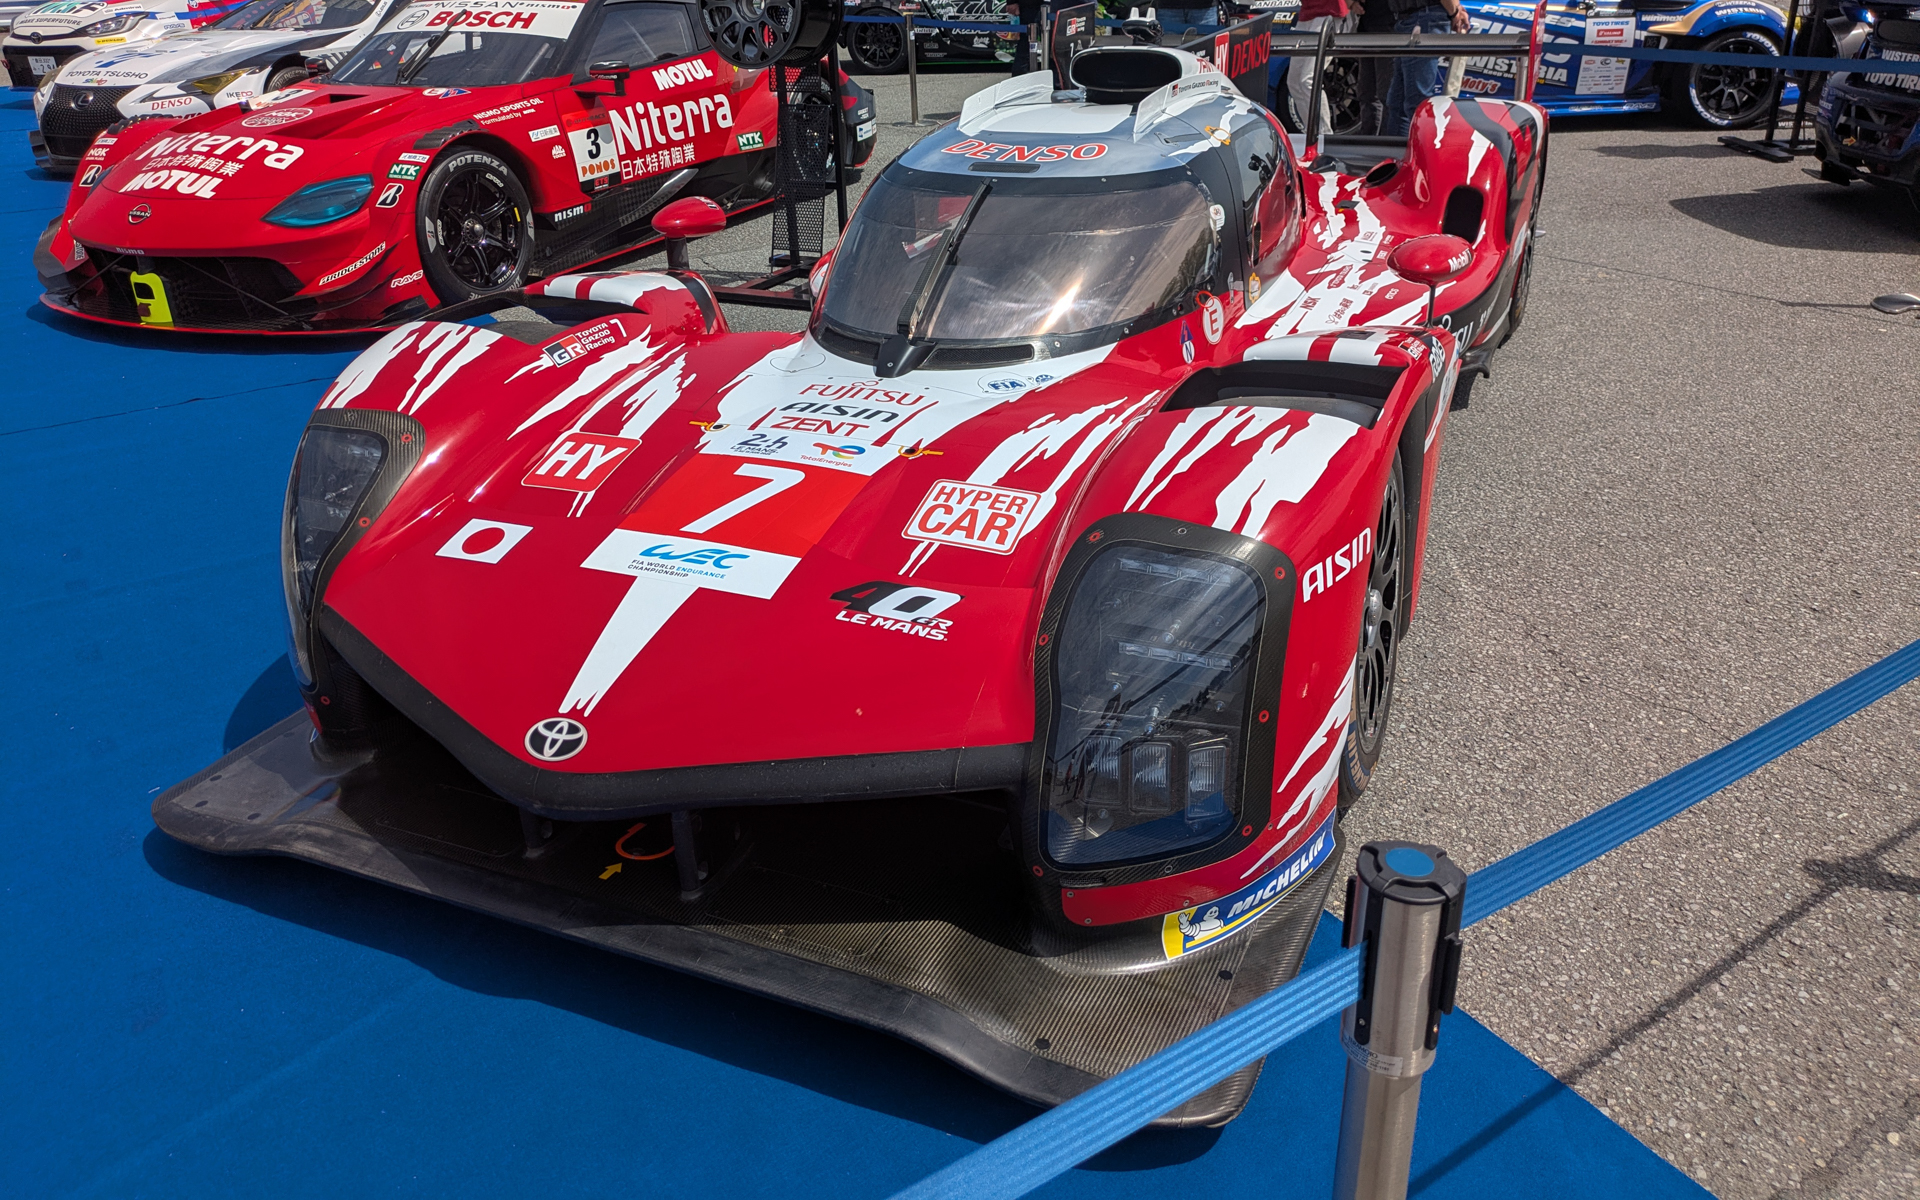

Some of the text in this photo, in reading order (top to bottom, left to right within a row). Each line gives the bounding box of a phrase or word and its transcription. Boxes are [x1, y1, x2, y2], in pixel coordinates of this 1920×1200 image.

[439, 1, 519, 9] NISSAN
[35, 17, 83, 26] SUPERFUTURE
[425, 11, 538, 30] BOSCH
[1274, 12, 1296, 20] ECU
[1231, 31, 1271, 79] DENSO
[103, 71, 149, 79] TSUSHO
[651, 58, 714, 91] MOTUL
[1461, 76, 1499, 93] Moty's
[152, 97, 193, 111] DENSO
[226, 91, 253, 99] IKEDO
[473, 98, 544, 120] NISMO SPORTS OIL
[481, 113, 514, 125] Formulated
[609, 93, 735, 156] Niterra
[586, 127, 602, 160] 3
[738, 131, 763, 146] NTK
[88, 148, 110, 157] NGK
[136, 131, 305, 170] Niterra
[621, 142, 696, 180] 日本特殊陶業
[941, 138, 1109, 163] DENSO
[142, 153, 245, 178] 日本特殊陶業
[390, 163, 421, 176] NTK
[448, 154, 508, 177] POTENZA
[580, 158, 616, 178] PONOS
[118, 169, 225, 199] MOTUL
[594, 176, 609, 187] ETS
[554, 203, 592, 222] nismo
[116, 247, 145, 255] nismo
[319, 241, 386, 287] BRIDGESTONE
[391, 269, 423, 288] RAYS
[1300, 296, 1321, 310] NSK
[575, 322, 608, 339] TOYOTA
[609, 318, 627, 338] 7
[1208, 308, 1219, 335] E
[580, 329, 611, 344] GAZOO
[585, 335, 615, 351] Racing
[552, 343, 585, 364] GR
[1184, 341, 1194, 363] N
[798, 382, 927, 407] FUJITSU
[989, 380, 1023, 391] FIA
[779, 402, 900, 423] AISIN
[769, 416, 870, 437] ZENT
[535, 440, 628, 481] HY
[800, 454, 853, 468] TotalEnergies
[679, 462, 806, 535] 7
[932, 485, 1029, 515] HYPER
[918, 503, 1016, 546] CAR
[639, 544, 751, 570] WEC
[1302, 527, 1371, 604] AISIN
[627, 564, 689, 578] CHAMPIONSHIP
[646, 560, 676, 571] WORLD
[675, 566, 727, 579] ENDURANCE
[829, 580, 967, 622] 40
[835, 610, 949, 641] LE MANS
[1226, 831, 1327, 919] MICHELIN
